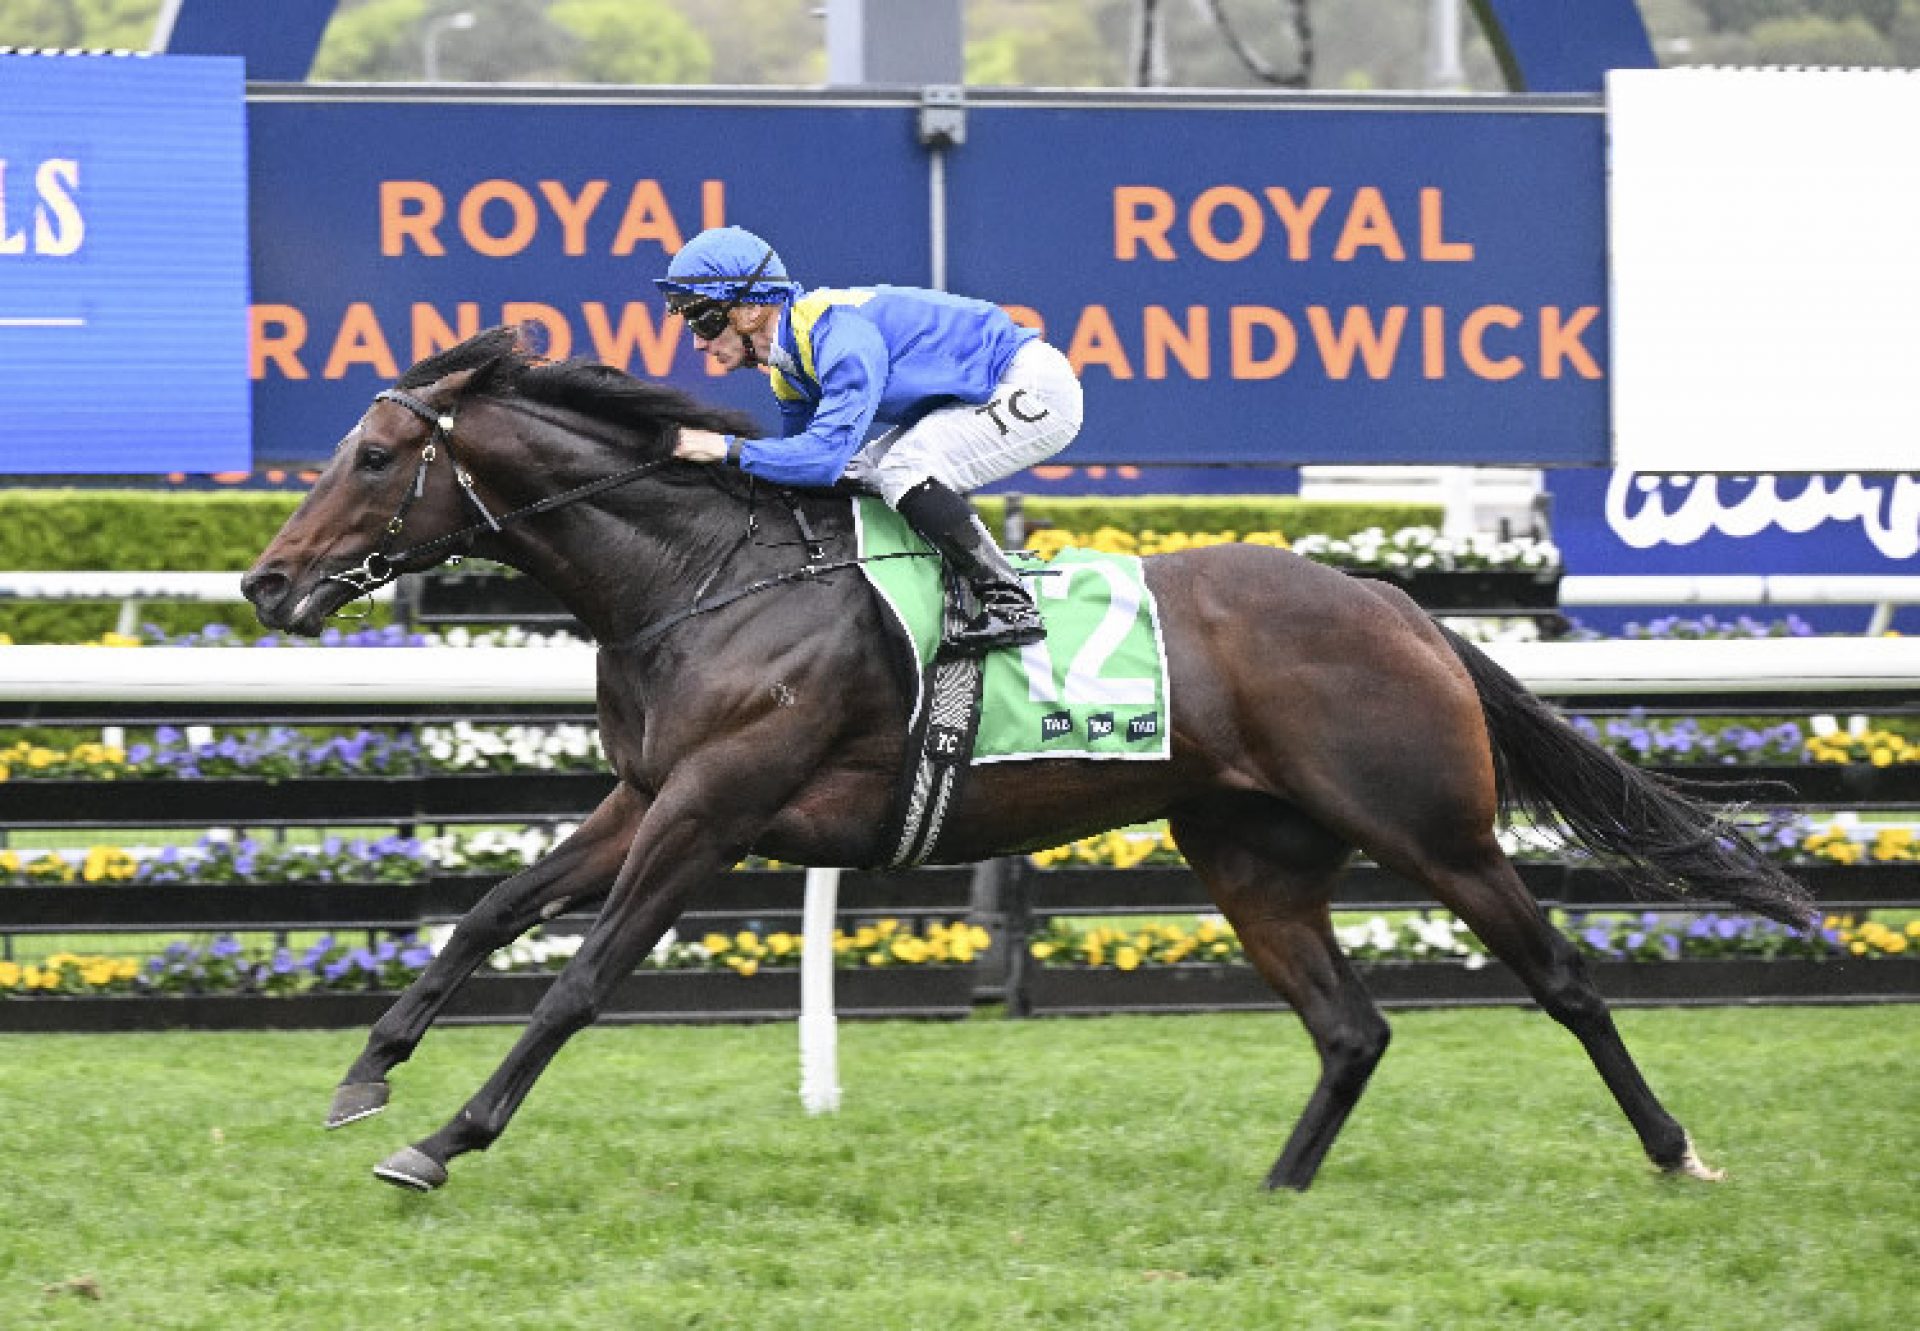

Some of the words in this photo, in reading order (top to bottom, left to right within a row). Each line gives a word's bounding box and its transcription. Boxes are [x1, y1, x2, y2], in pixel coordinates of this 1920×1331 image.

[1113, 186, 1475, 262] ROYAL
[975, 389, 1049, 435] TC
[1020, 558, 1156, 705] 12
